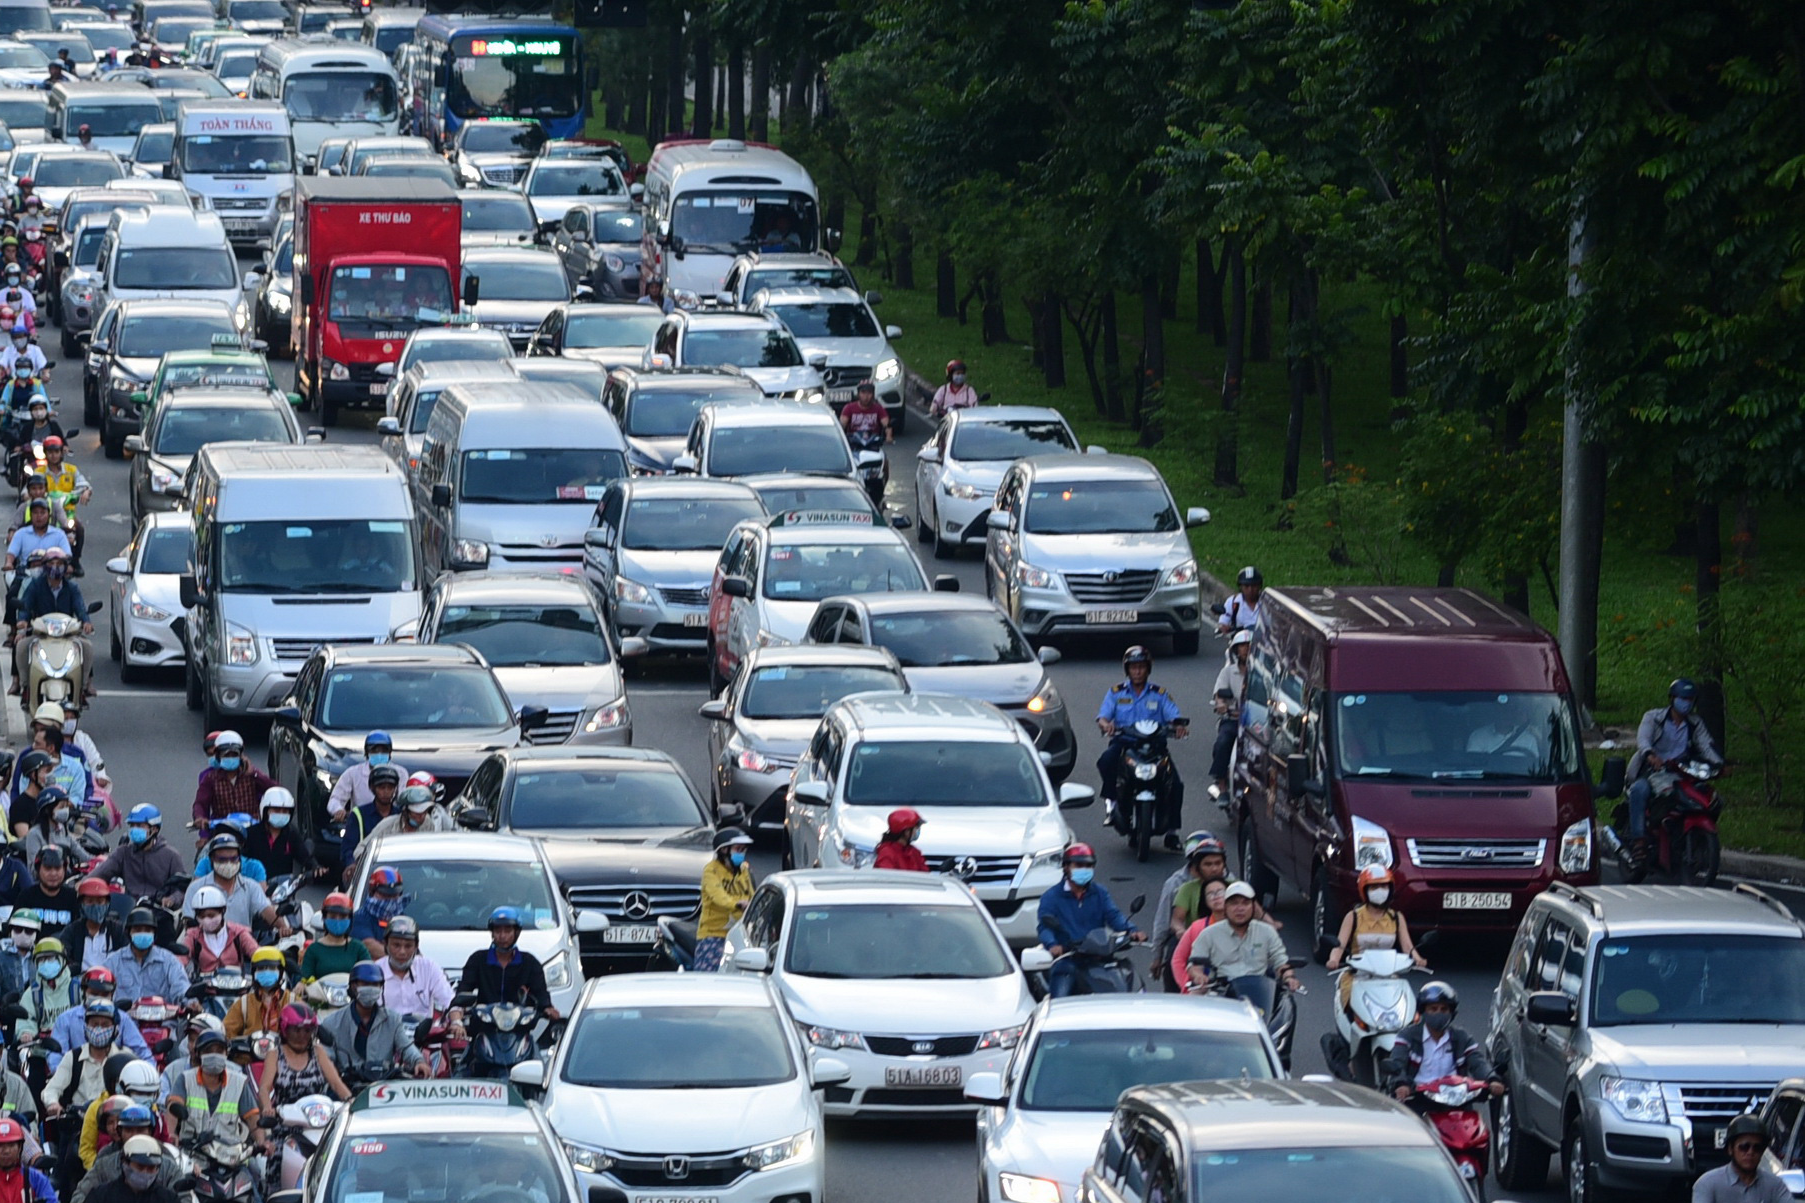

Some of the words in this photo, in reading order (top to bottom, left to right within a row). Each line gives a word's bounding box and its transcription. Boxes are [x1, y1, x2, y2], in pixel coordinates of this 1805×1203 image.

[200, 117, 229, 131] TOÀN
[359, 212, 371, 223] XE
[373, 211, 391, 223] THƯ
[392, 210, 411, 223] BÁO
[375, 330, 407, 340] ISUZU
[218, 376, 250, 387] VINASUN
[806, 512, 850, 523] VINASUN
[851, 513, 871, 523] TAXI
[915, 1042, 933, 1052] KIA
[401, 1085, 470, 1099] VINASUN
[470, 1085, 503, 1098] TAXI
